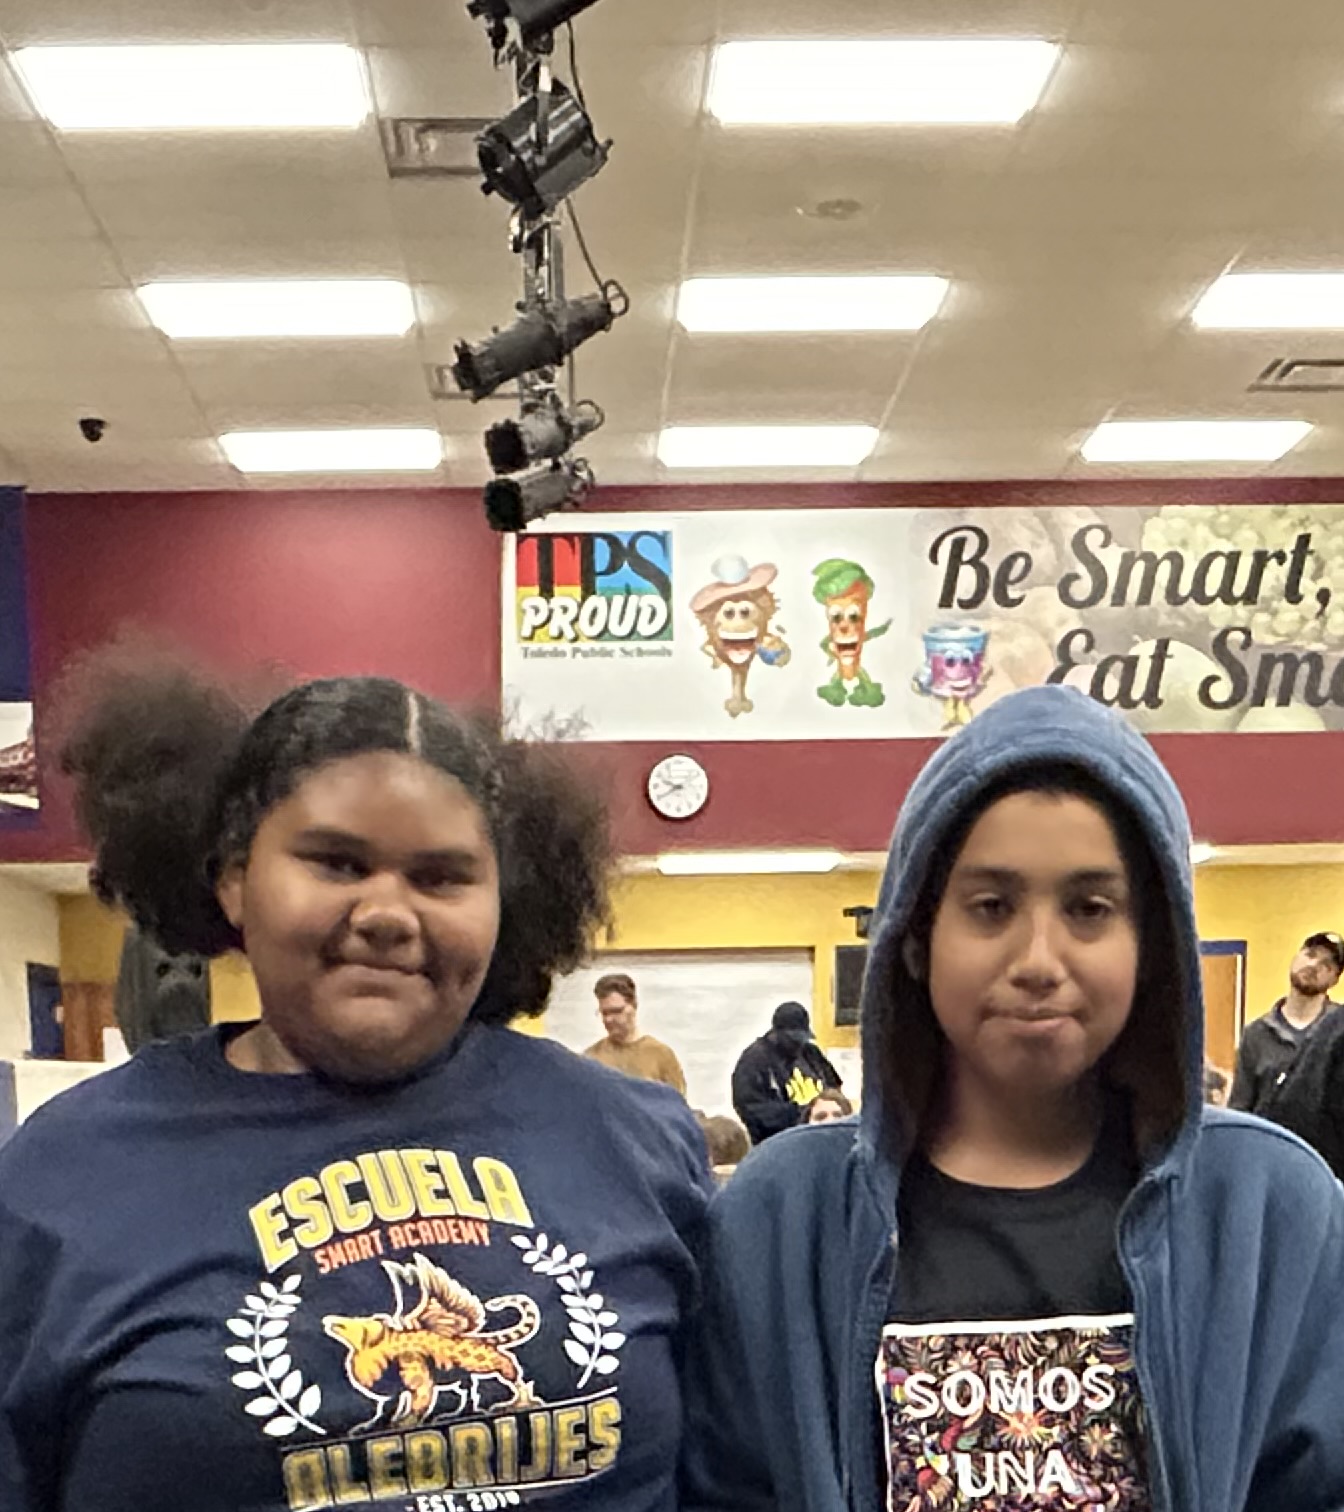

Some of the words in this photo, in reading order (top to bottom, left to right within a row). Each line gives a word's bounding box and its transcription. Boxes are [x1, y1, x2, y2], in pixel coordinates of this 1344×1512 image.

[517, 531, 673, 602] TPS
[927, 525, 1034, 611] Be
[1056, 525, 1333, 616] Smart,
[520, 595, 669, 642] PROUD
[1045, 628, 1174, 710] Eat
[249, 1148, 535, 1273] ESCUELA
[314, 1228, 385, 1275] SMART
[388, 1218, 491, 1251] ACADEMY
[904, 1364, 1116, 1418] SOMOS
[953, 1449, 1078, 1498] UNA
